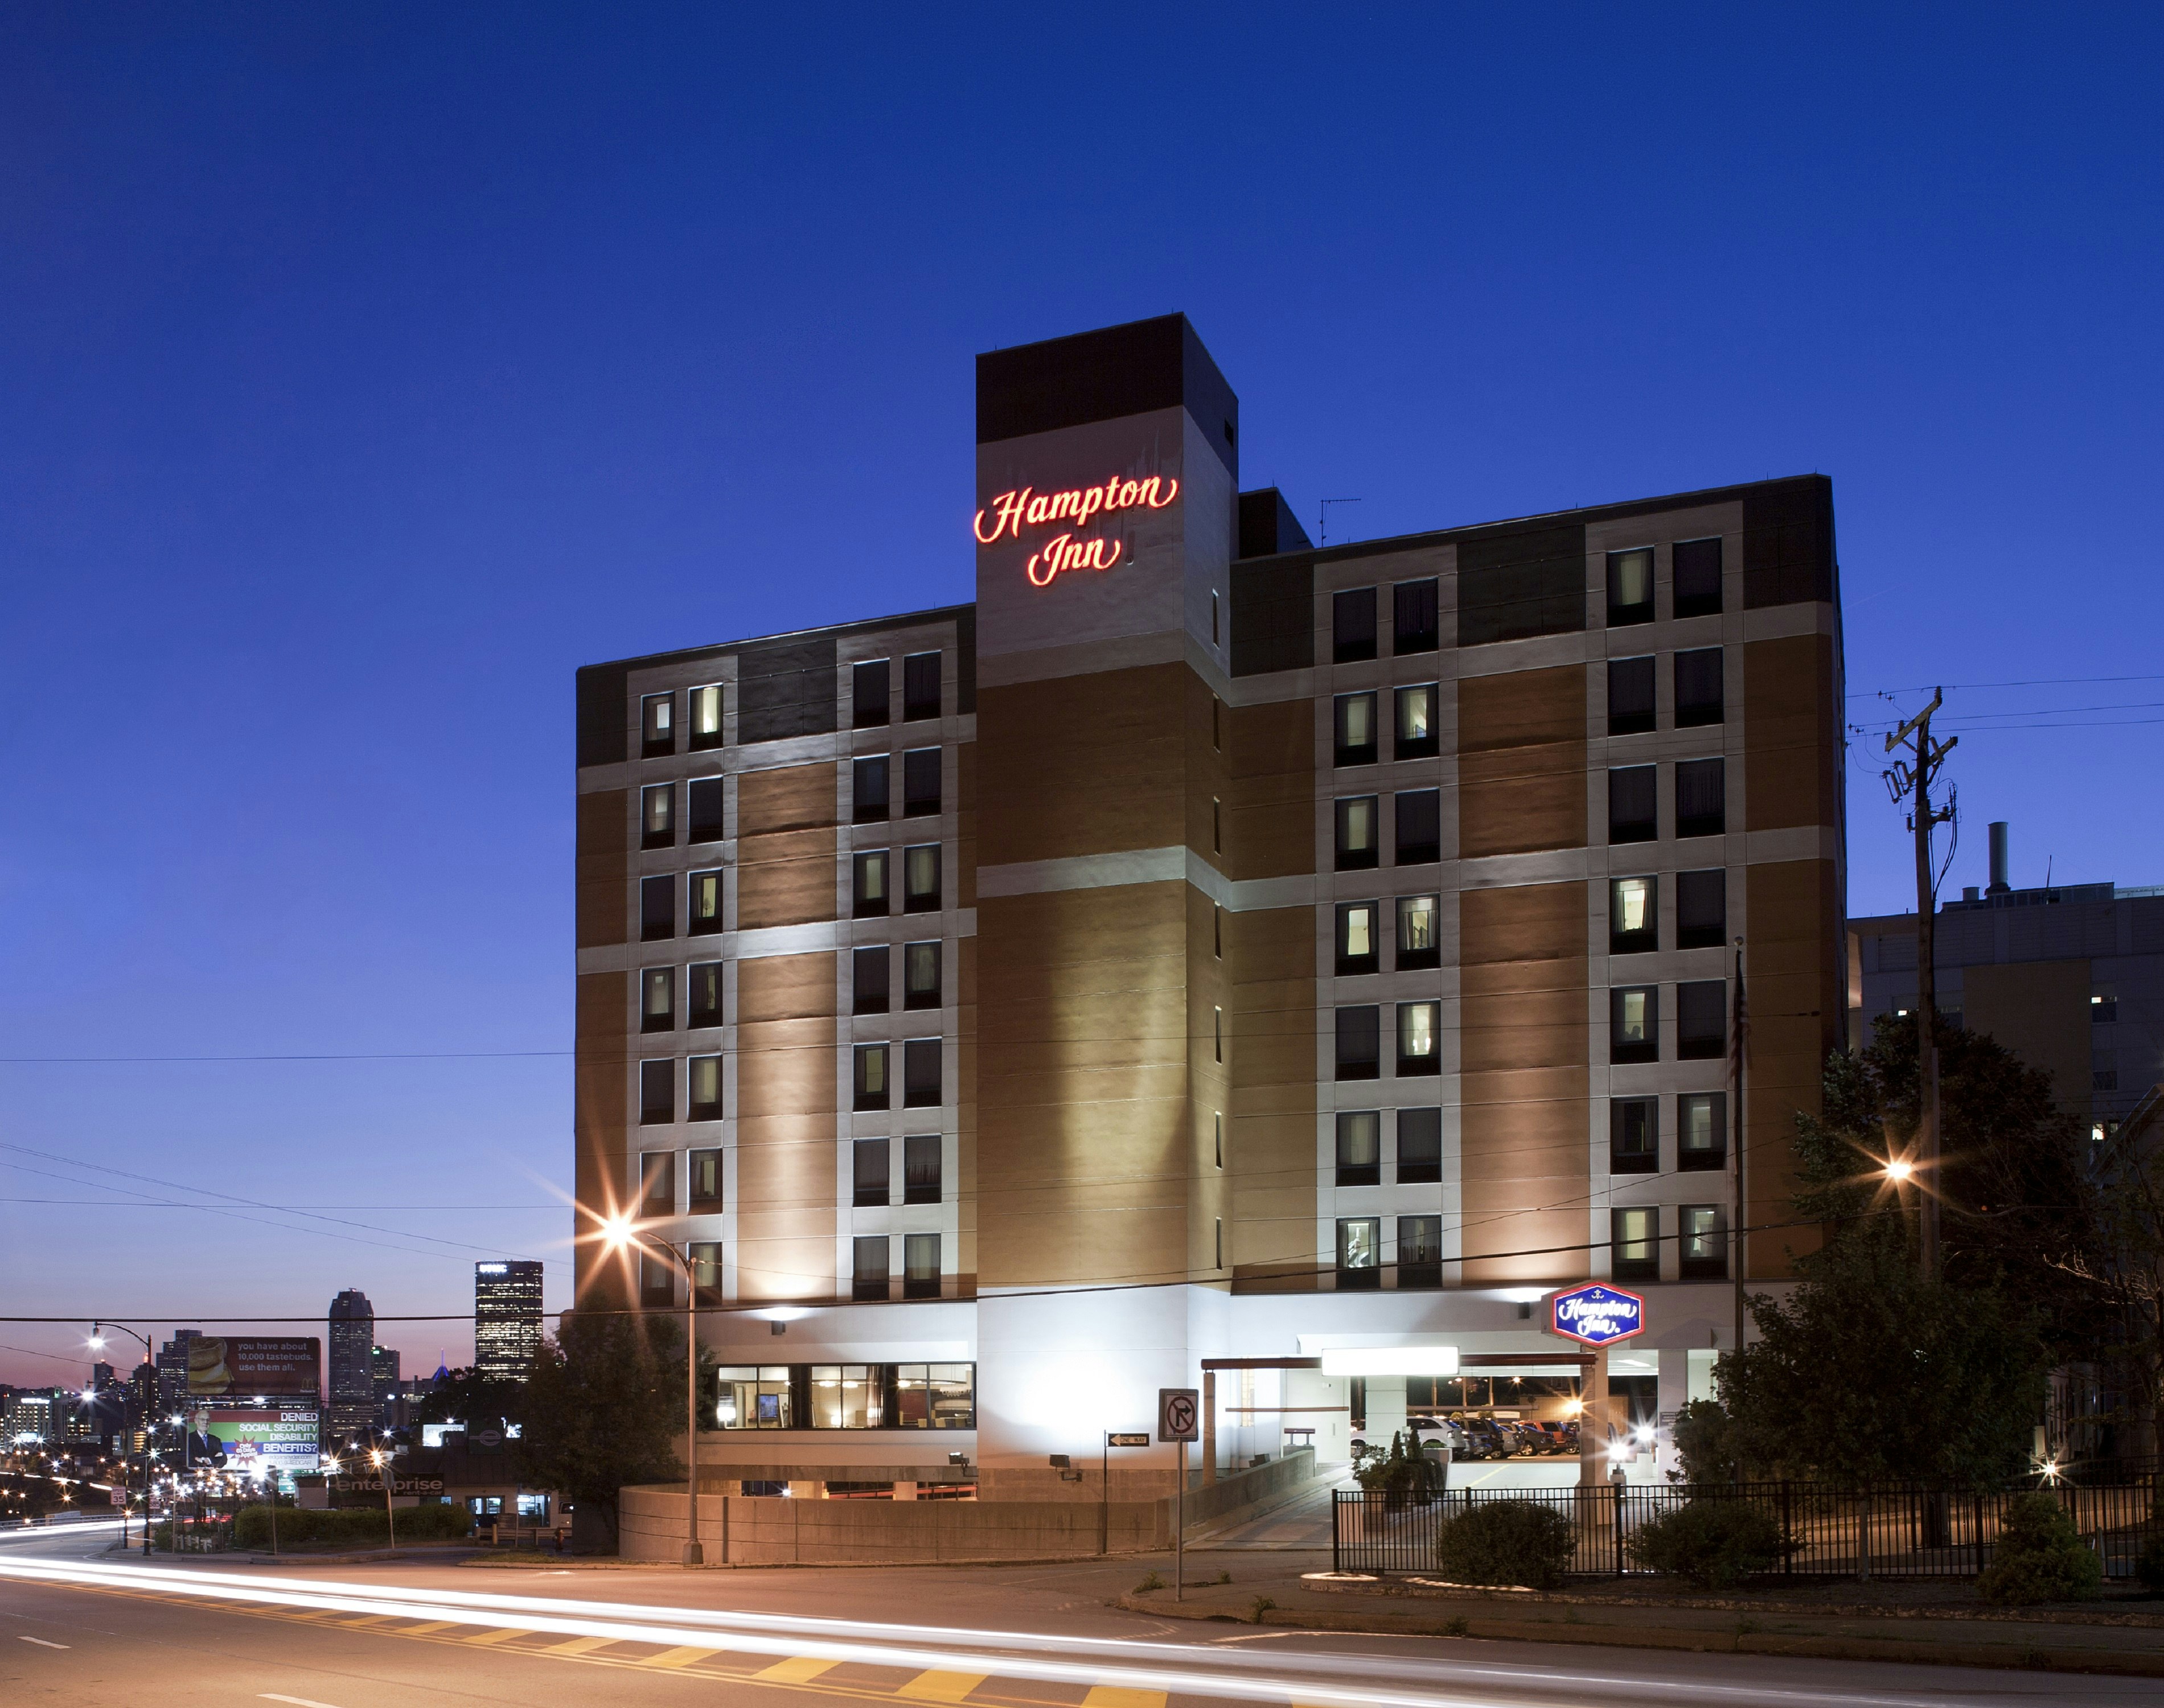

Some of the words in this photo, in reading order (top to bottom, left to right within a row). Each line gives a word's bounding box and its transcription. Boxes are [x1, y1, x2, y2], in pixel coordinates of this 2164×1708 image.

[974, 475, 1179, 543] Hampton
[1028, 533, 1121, 586] Inn
[1558, 1298, 1637, 1320] Hampton
[281, 1413, 318, 1421] DENIED
[263, 1443, 317, 1452] BENEFITS?
[330, 1477, 443, 1493] enteprise
